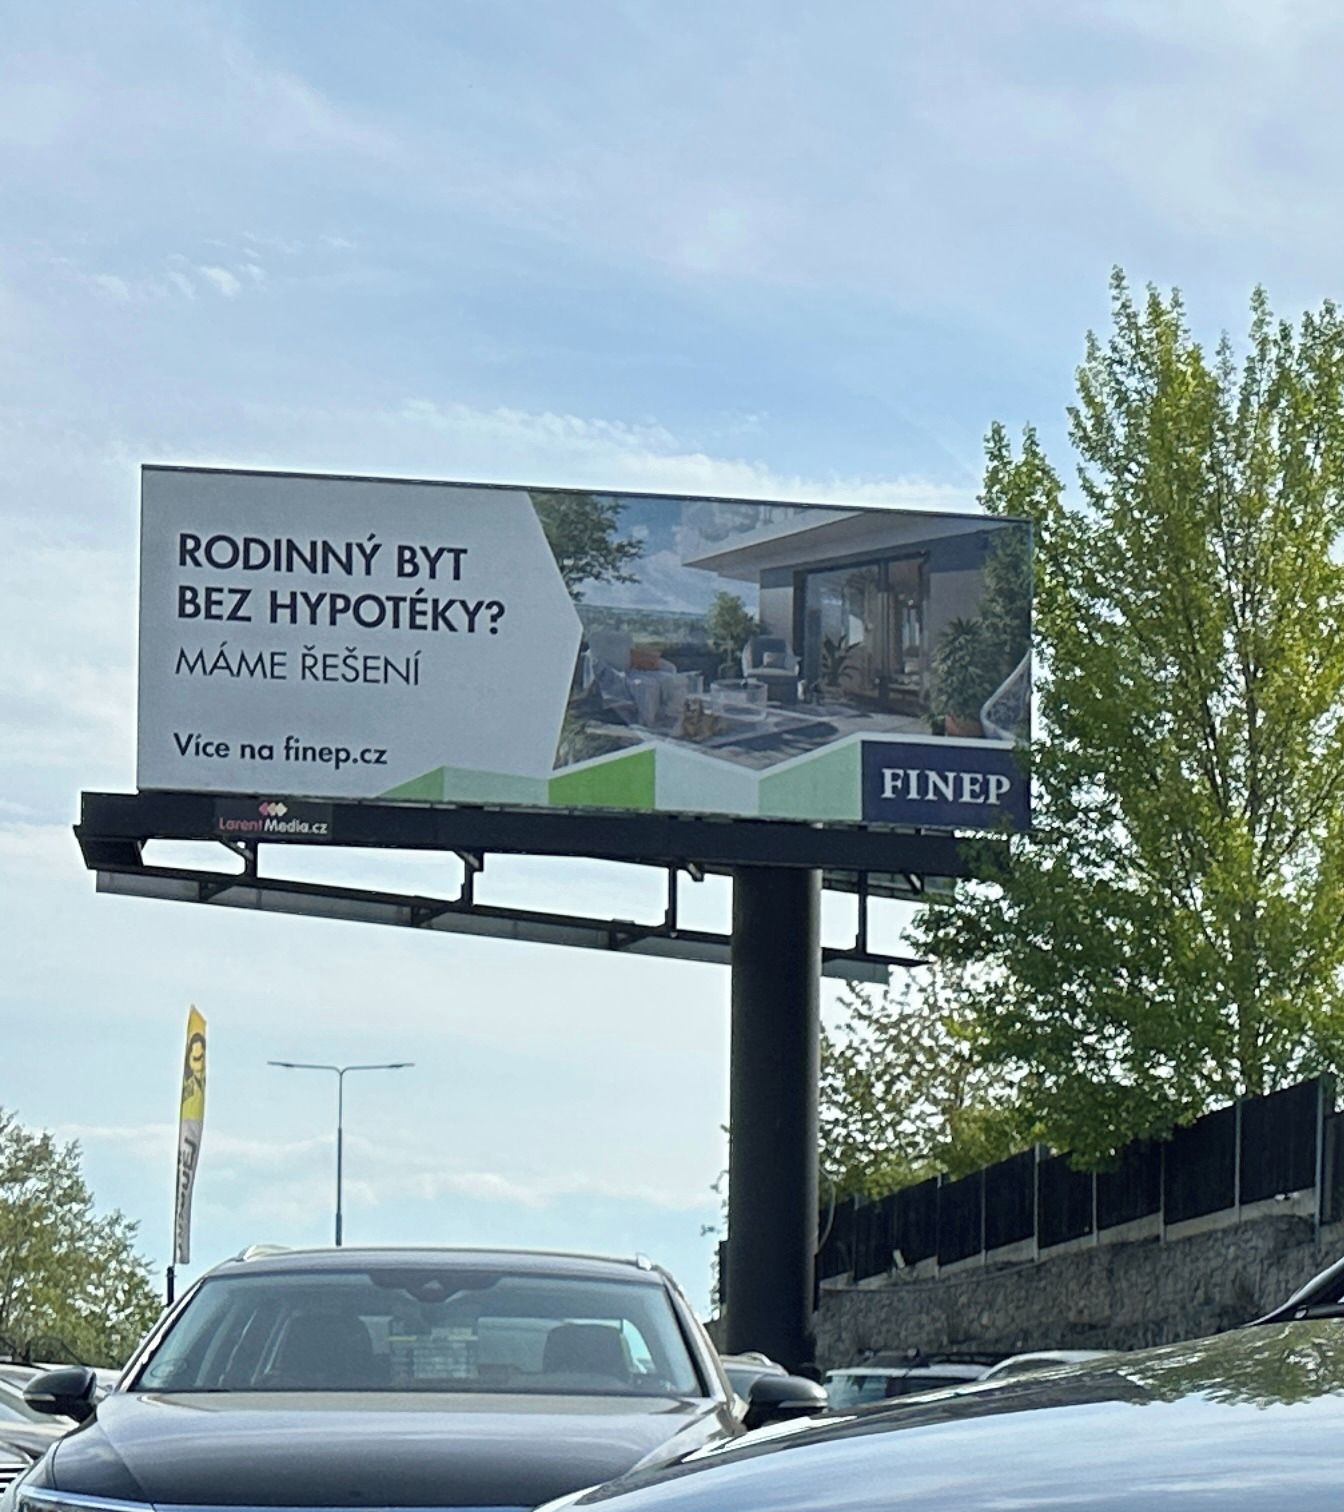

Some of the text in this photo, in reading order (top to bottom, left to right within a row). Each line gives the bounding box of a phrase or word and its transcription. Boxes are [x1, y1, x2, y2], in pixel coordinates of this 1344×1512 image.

[178, 532, 469, 581] RODINNÝ BYT
[177, 585, 506, 635] BEZ HYPOTÉKY?
[174, 641, 422, 686] MÁME ŘEŠENÍ
[173, 732, 388, 770] Více na finep.cz
[880, 768, 1011, 805] FINEP
[218, 817, 328, 835] LarentMedia.cz
